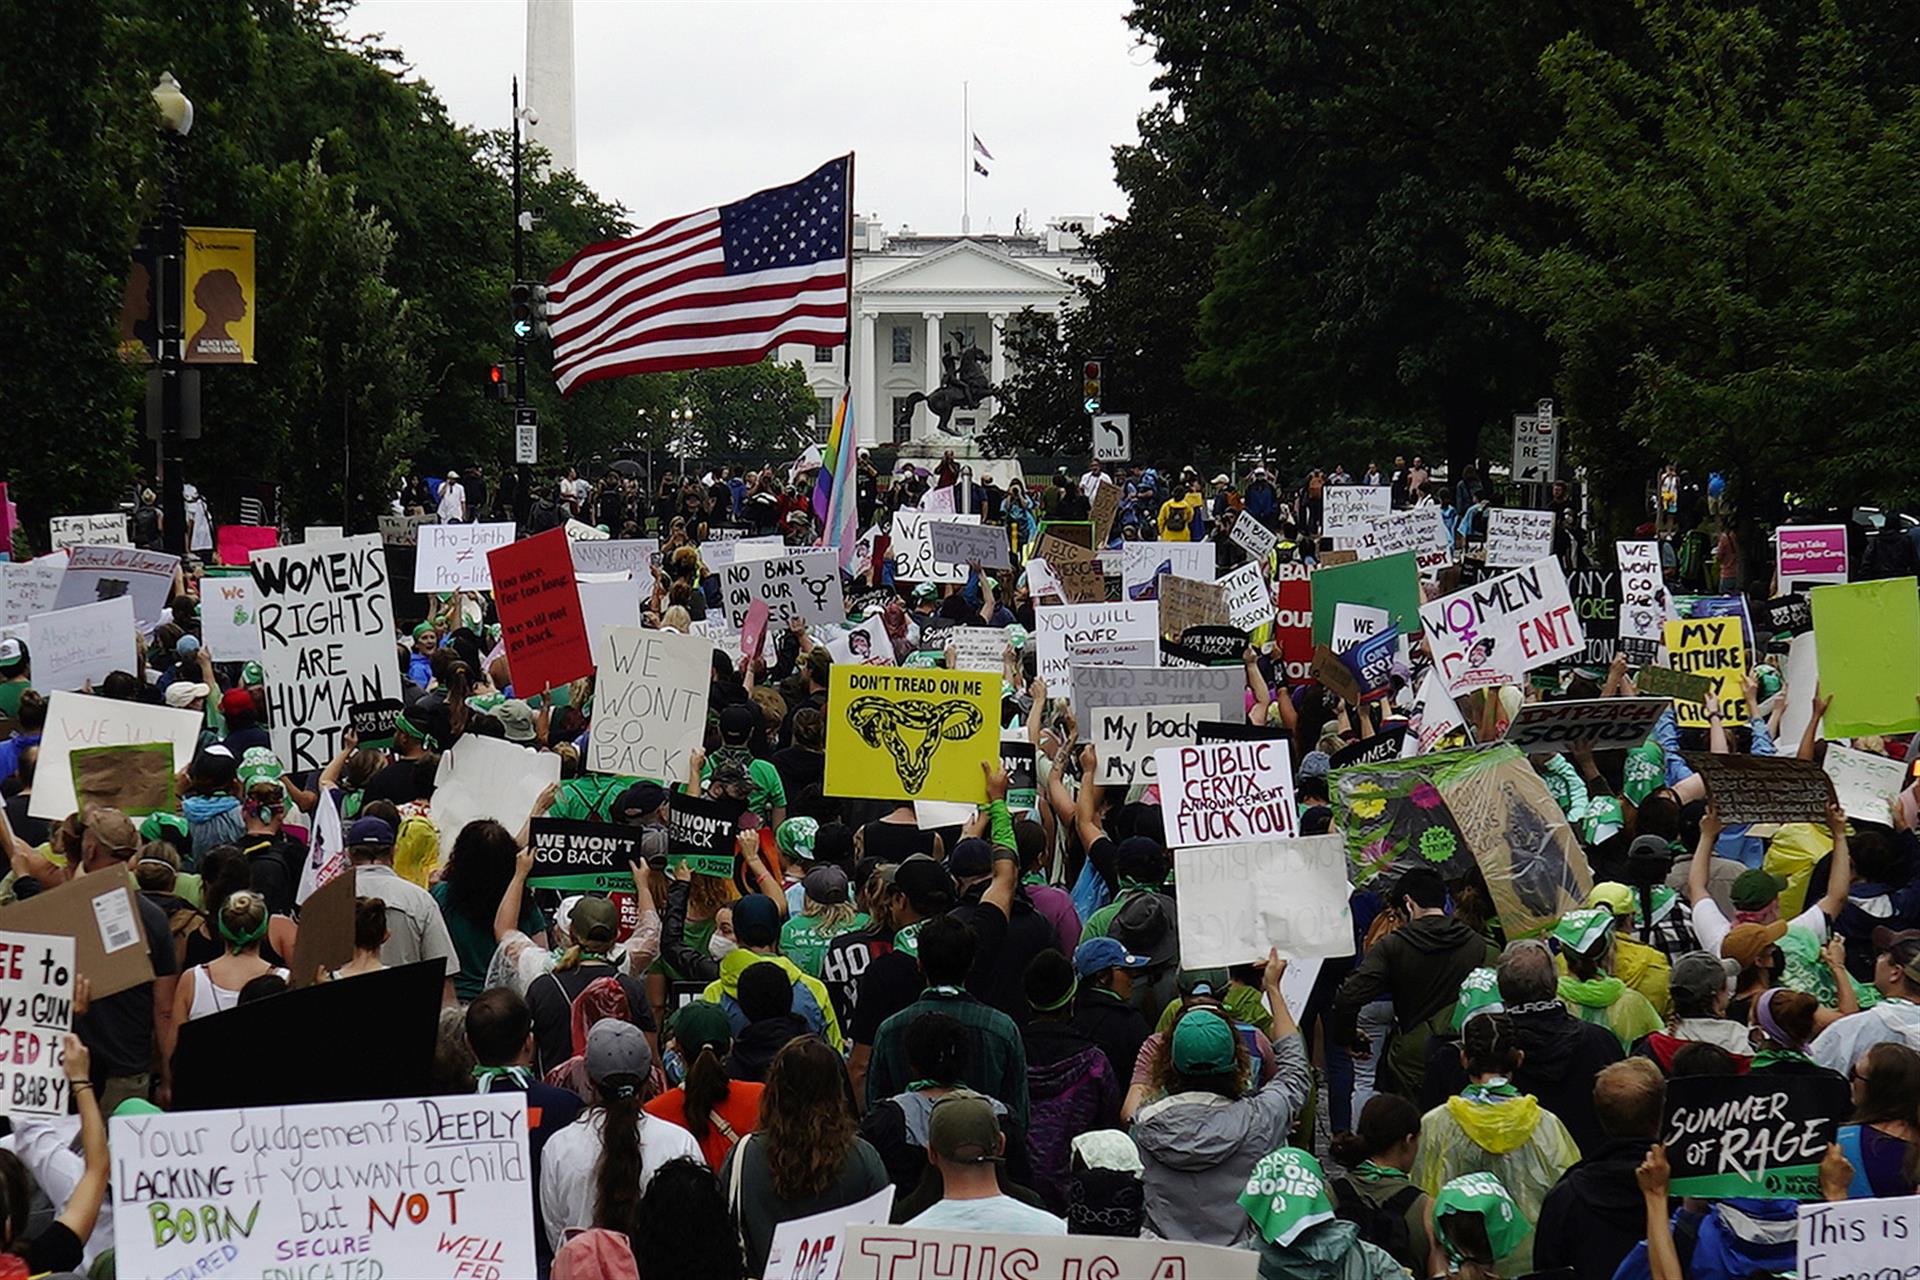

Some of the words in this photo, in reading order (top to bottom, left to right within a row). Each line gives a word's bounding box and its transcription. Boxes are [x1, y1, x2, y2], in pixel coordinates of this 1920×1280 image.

[1098, 448, 1125, 458] ONLY
[1325, 487, 1352, 500] Keep
[434, 527, 506, 548] Pro-birth
[1051, 540, 1079, 559] BIG
[1363, 533, 1377, 549] 12
[1622, 544, 1649, 557] WE
[1781, 540, 1806, 550] Don't
[1807, 540, 1827, 549] Take
[893, 552, 964, 579] BACK
[1416, 551, 1448, 568] BABY
[1781, 551, 1806, 560] Away
[1806, 550, 1822, 559] Our
[251, 549, 385, 597] WOMENS
[727, 566, 750, 584] NO
[764, 560, 805, 580] BANS
[1628, 578, 1652, 591] GO
[521, 585, 540, 600] too
[730, 587, 750, 605] ON
[761, 583, 793, 599] OUR
[1422, 566, 1543, 645] WOMEN
[259, 593, 385, 650] RIGHTS
[526, 611, 547, 629] will
[549, 606, 568, 620] not
[732, 600, 798, 629] BOES!
[1040, 611, 1077, 631] YOU
[1089, 609, 1136, 626] WILL
[1353, 617, 1375, 635] WE
[510, 639, 525, 653] go
[1680, 623, 1725, 648] MY
[297, 644, 347, 681] ARE
[610, 634, 663, 678] WE
[1042, 658, 1071, 674] HAV
[1669, 647, 1742, 673] FUTURE
[267, 664, 384, 730] HUMAN
[850, 674, 890, 691] DON'T
[894, 677, 937, 694] TREAD
[940, 679, 959, 695] ON
[963, 680, 982, 696] ME
[1711, 675, 1725, 695] Y
[601, 680, 702, 723] WONT
[1517, 702, 1661, 725] IMPEACH
[1678, 699, 1749, 722] CHOCE
[354, 712, 377, 723] WE
[356, 722, 376, 732] GO
[594, 717, 643, 744] GO
[1103, 715, 1138, 752] My
[1516, 721, 1650, 745] SCOTUS
[596, 745, 682, 779] BACK
[1106, 756, 1136, 784] My
[1181, 743, 1271, 782] PUBLIC
[1185, 773, 1261, 801] CERVIX
[1180, 786, 1284, 816] ANNOUNCEMENT
[681, 811, 732, 837] WON'T
[1177, 808, 1242, 844] FUCK
[1240, 799, 1295, 838] YOU!
[535, 833, 566, 849] WE
[569, 834, 635, 853] WON'T
[679, 827, 713, 849] BACK
[534, 847, 563, 863] GO
[566, 850, 614, 866] BACK
[0, 943, 25, 981] EE
[40, 948, 69, 986] to
[16, 999, 28, 1018] a
[32, 992, 70, 1026] GUN
[0, 1028, 40, 1066] CED
[12, 1072, 66, 1111] BABY
[125, 1117, 210, 1159] Your
[403, 1119, 424, 1144] is
[417, 1099, 521, 1145] DEEPLY
[1662, 1092, 1790, 1147] SUMMER
[1686, 1138, 1717, 1167] OF
[1718, 1117, 1830, 1184] RAGE
[119, 1158, 235, 1203] LACKING
[244, 1150, 268, 1195] if
[424, 1160, 445, 1185] a
[450, 1141, 526, 1183] child
[1246, 1176, 1320, 1199] BODIES
[148, 1199, 261, 1249] BORN
[297, 1194, 348, 1235] but
[368, 1188, 465, 1235] NOT
[1801, 1207, 1867, 1247] This
[1883, 1214, 1908, 1239] is
[276, 1234, 370, 1261] SECURE
[437, 1231, 504, 1264] WELL
[861, 1237, 1040, 1280] THIS
[1063, 1255, 1120, 1280] IS
[1149, 1255, 1187, 1280] A
